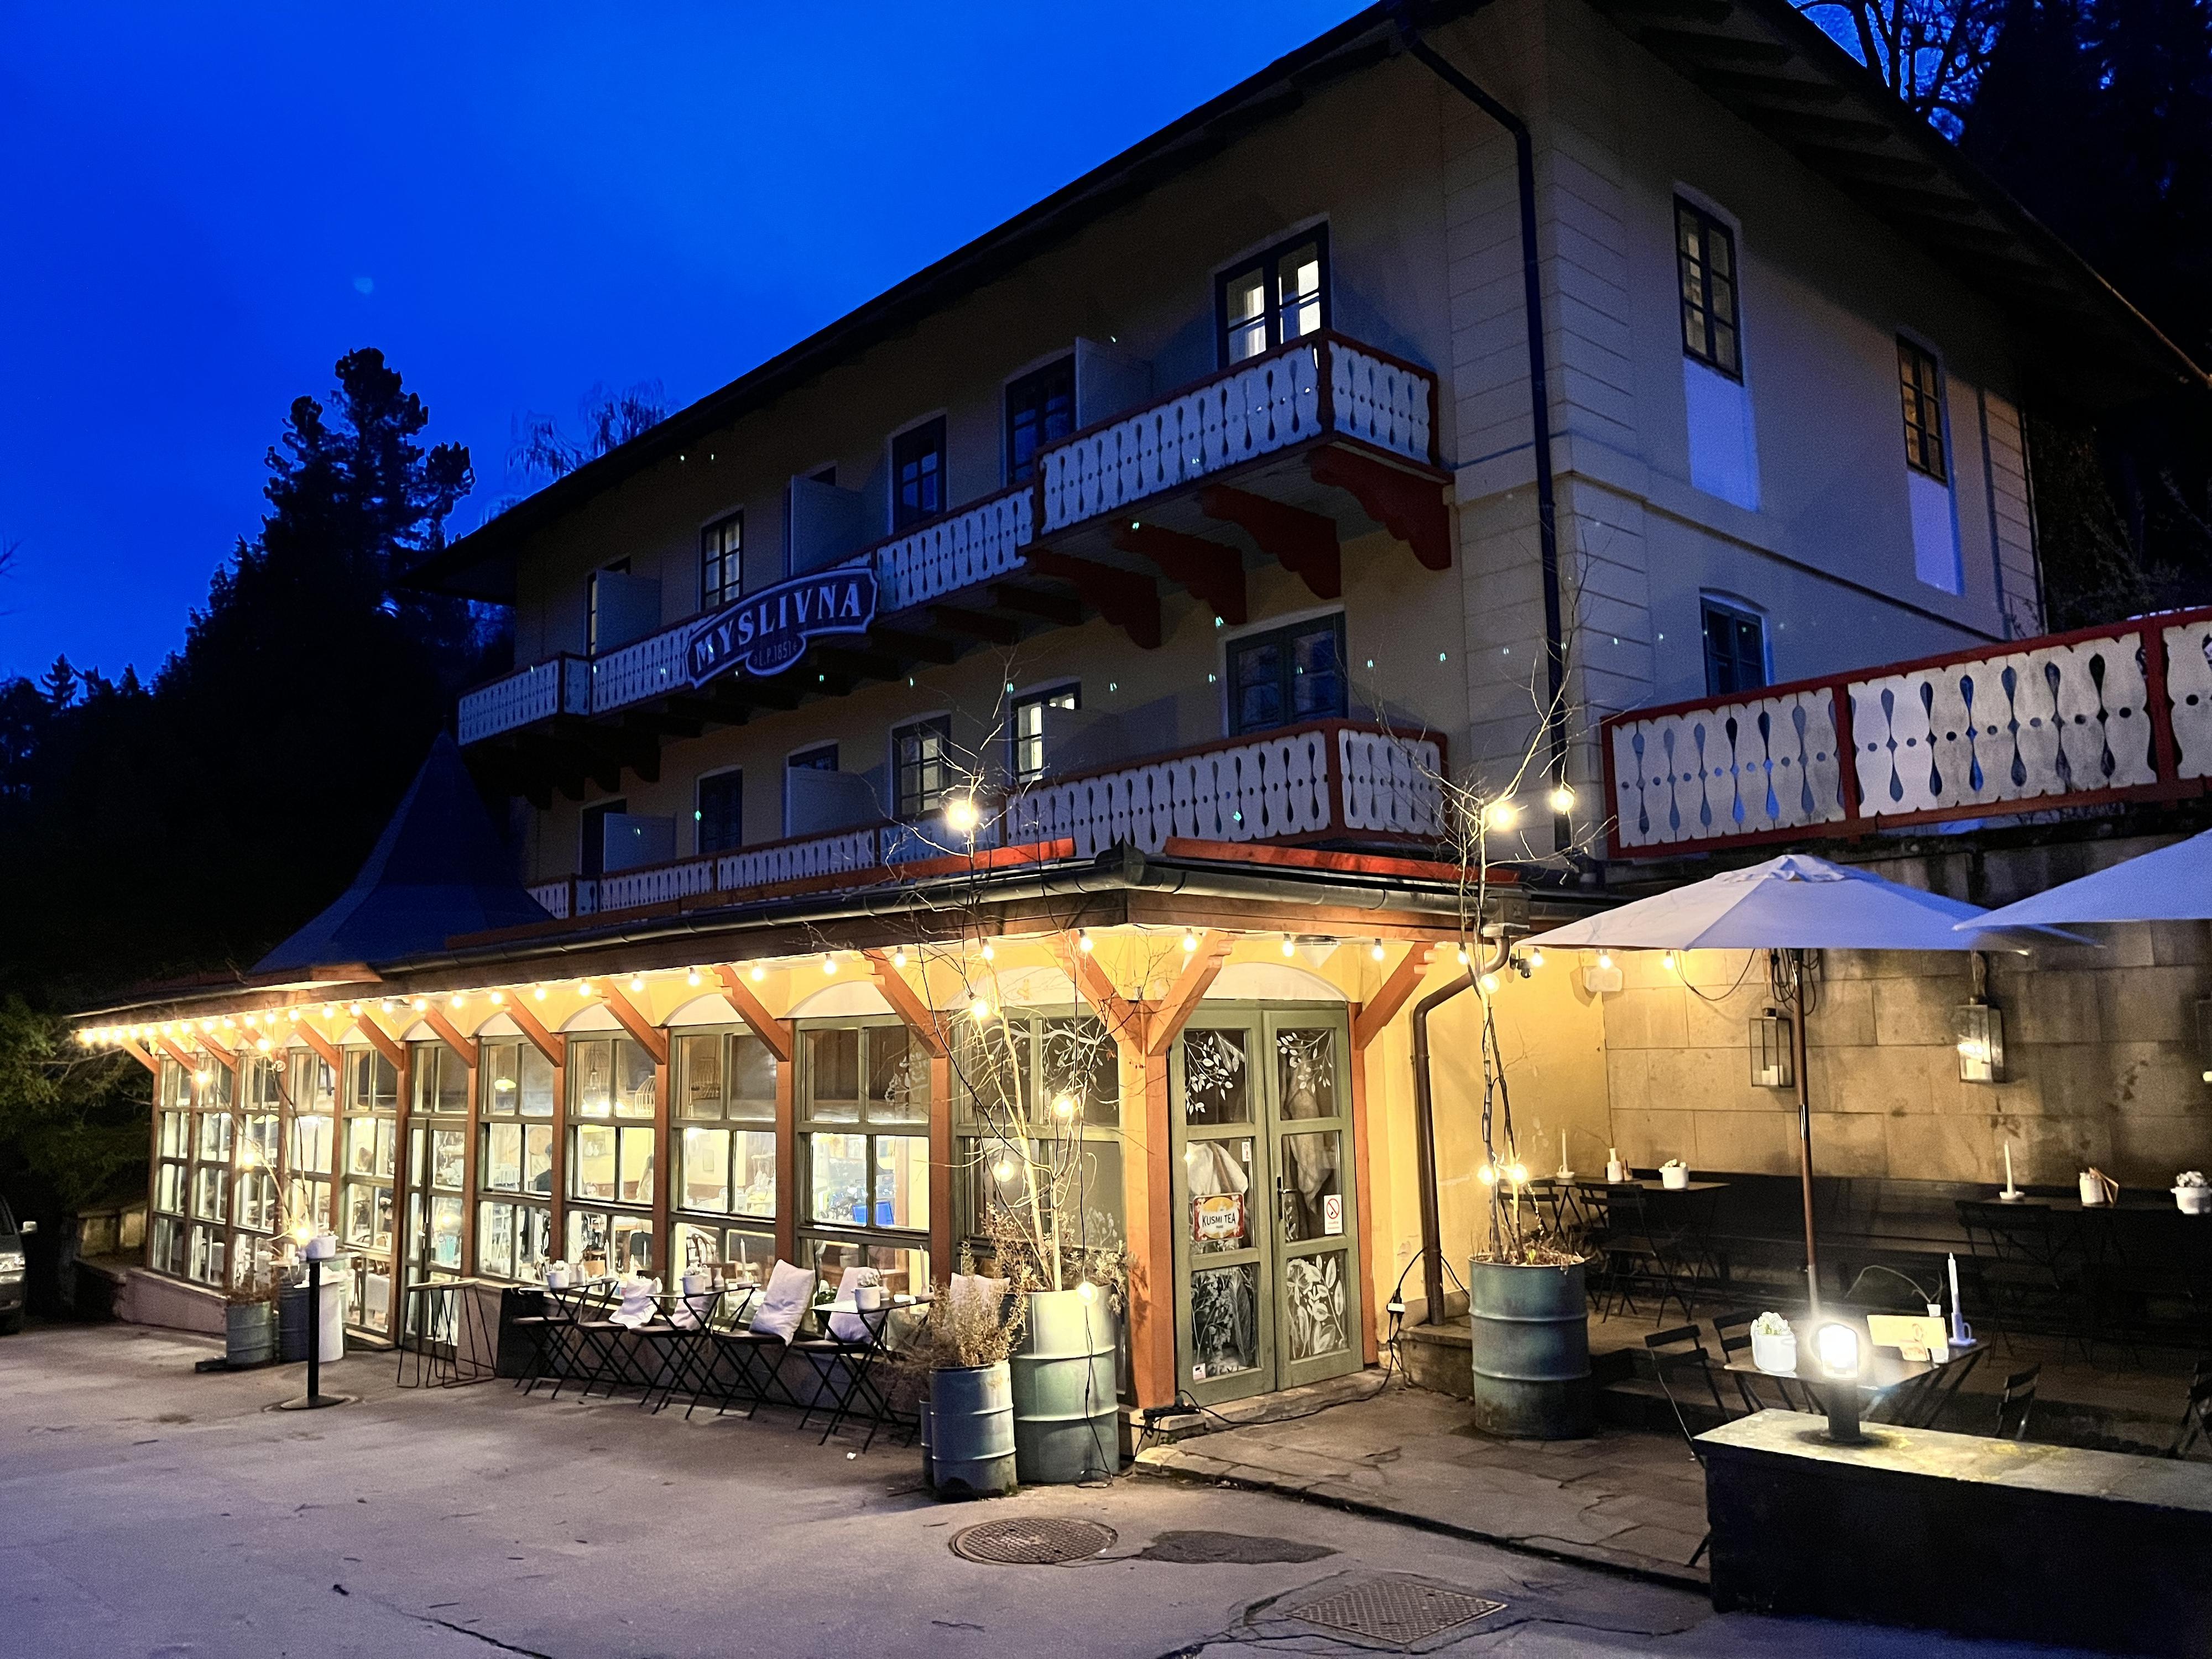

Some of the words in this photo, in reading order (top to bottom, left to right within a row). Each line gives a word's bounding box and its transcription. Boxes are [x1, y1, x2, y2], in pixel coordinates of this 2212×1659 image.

[695, 582, 861, 673] MYSLIVNA
[1202, 1215, 1222, 1227] KUSMI
[1224, 1212, 1235, 1224] TEA
